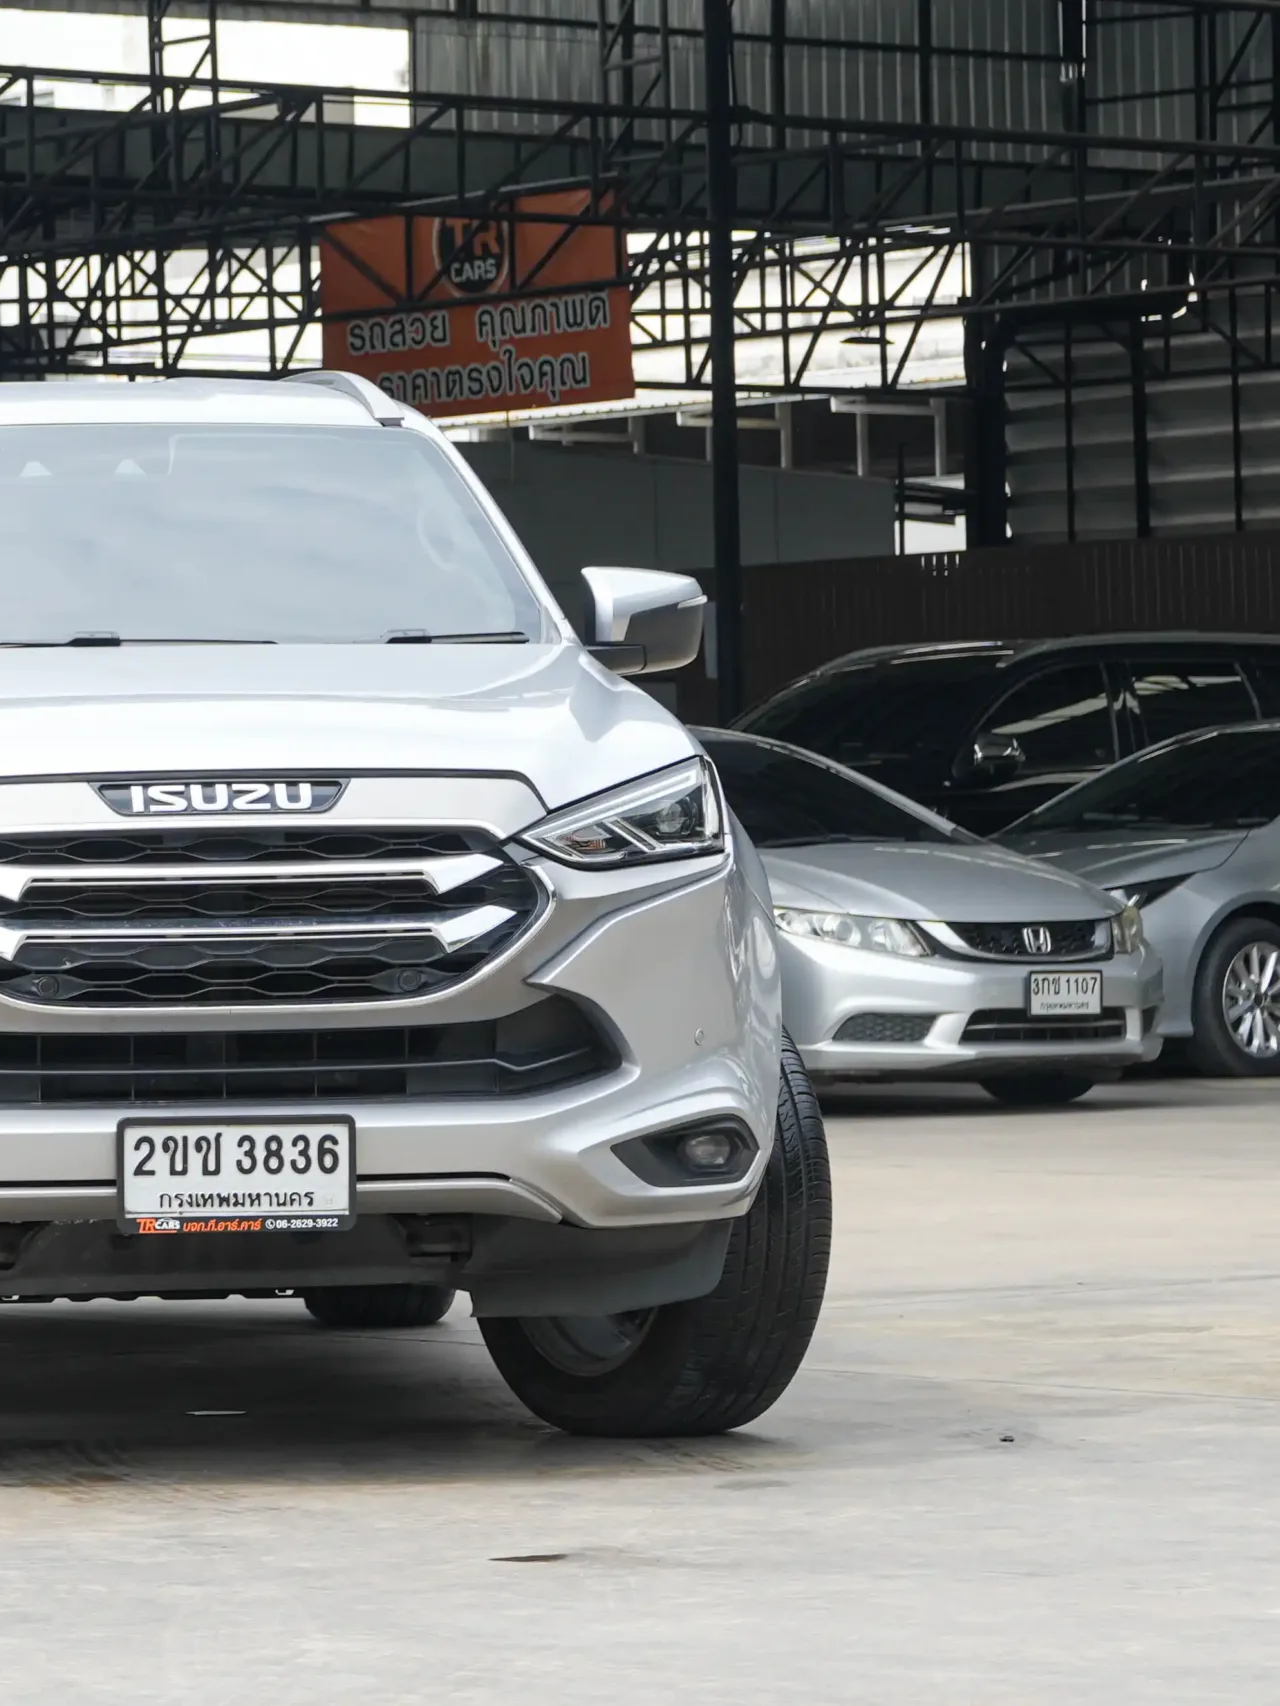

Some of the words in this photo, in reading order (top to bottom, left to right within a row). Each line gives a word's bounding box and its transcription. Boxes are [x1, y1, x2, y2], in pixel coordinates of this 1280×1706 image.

[450, 258, 497, 283] CARS
[348, 312, 449, 354] รถสวย
[130, 782, 312, 813] ISUZU
[1065, 976, 1098, 996] 1107
[235, 1133, 340, 1175] 3836
[158, 1190, 315, 1211] กรุงเทพมหานคร
[275, 1217, 339, 1229] 06-2629-3922
